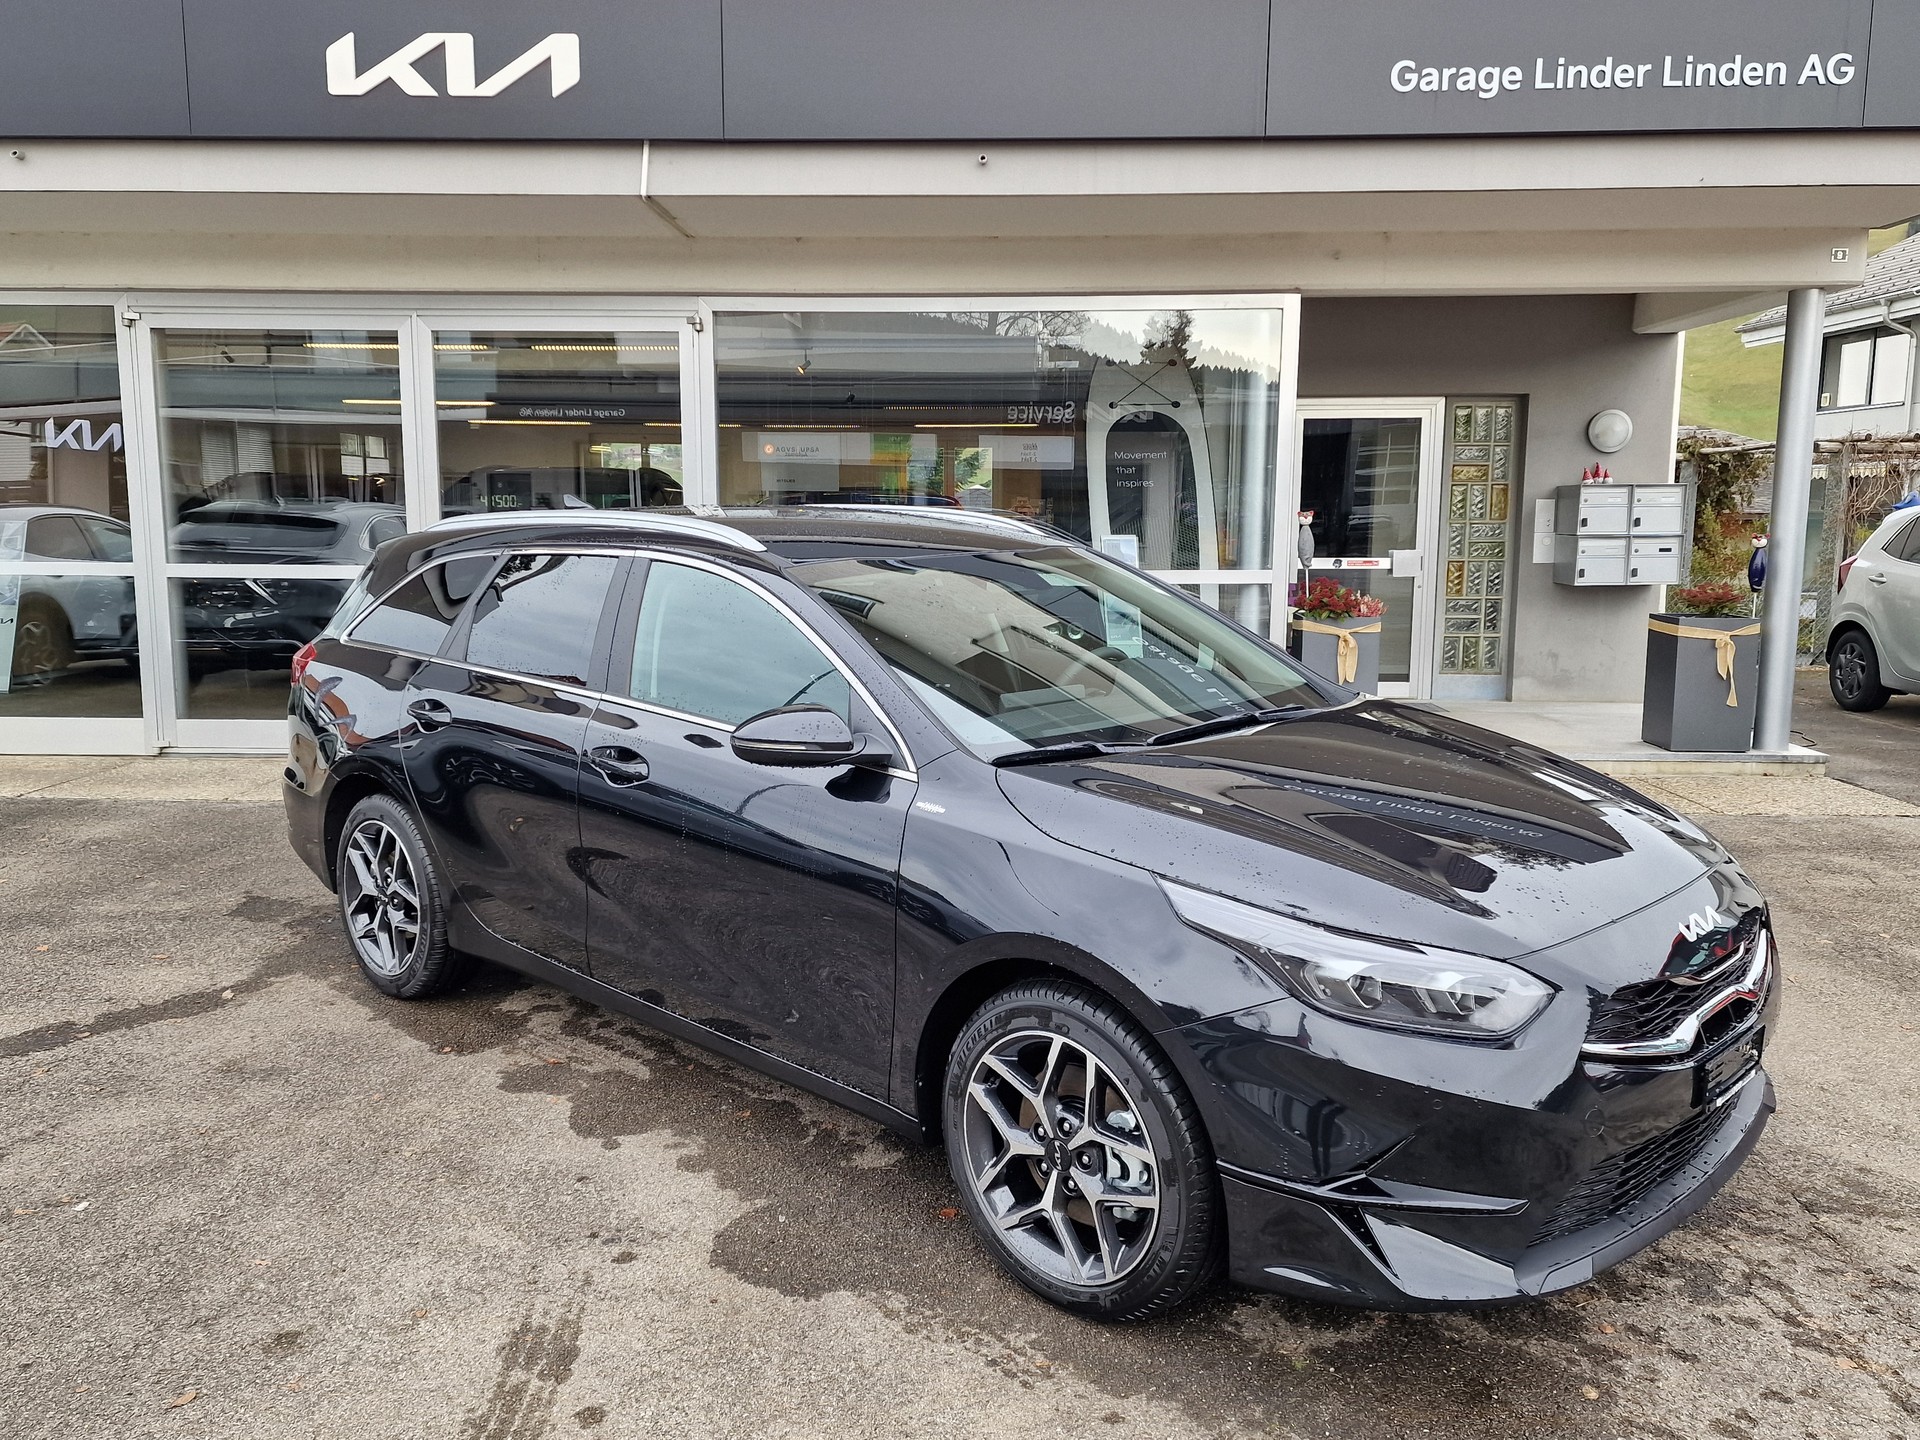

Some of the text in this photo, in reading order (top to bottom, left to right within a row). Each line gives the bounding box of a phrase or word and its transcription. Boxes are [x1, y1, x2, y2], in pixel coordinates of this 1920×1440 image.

[326, 32, 580, 98] KIA
[1391, 53, 1855, 99] Garage Linder Linden AG
[45, 417, 122, 452] KIA
[1114, 451, 1167, 459] Movement
[1116, 466, 1136, 474] that
[1116, 479, 1154, 488] inspires
[1679, 905, 1722, 942] KIA
